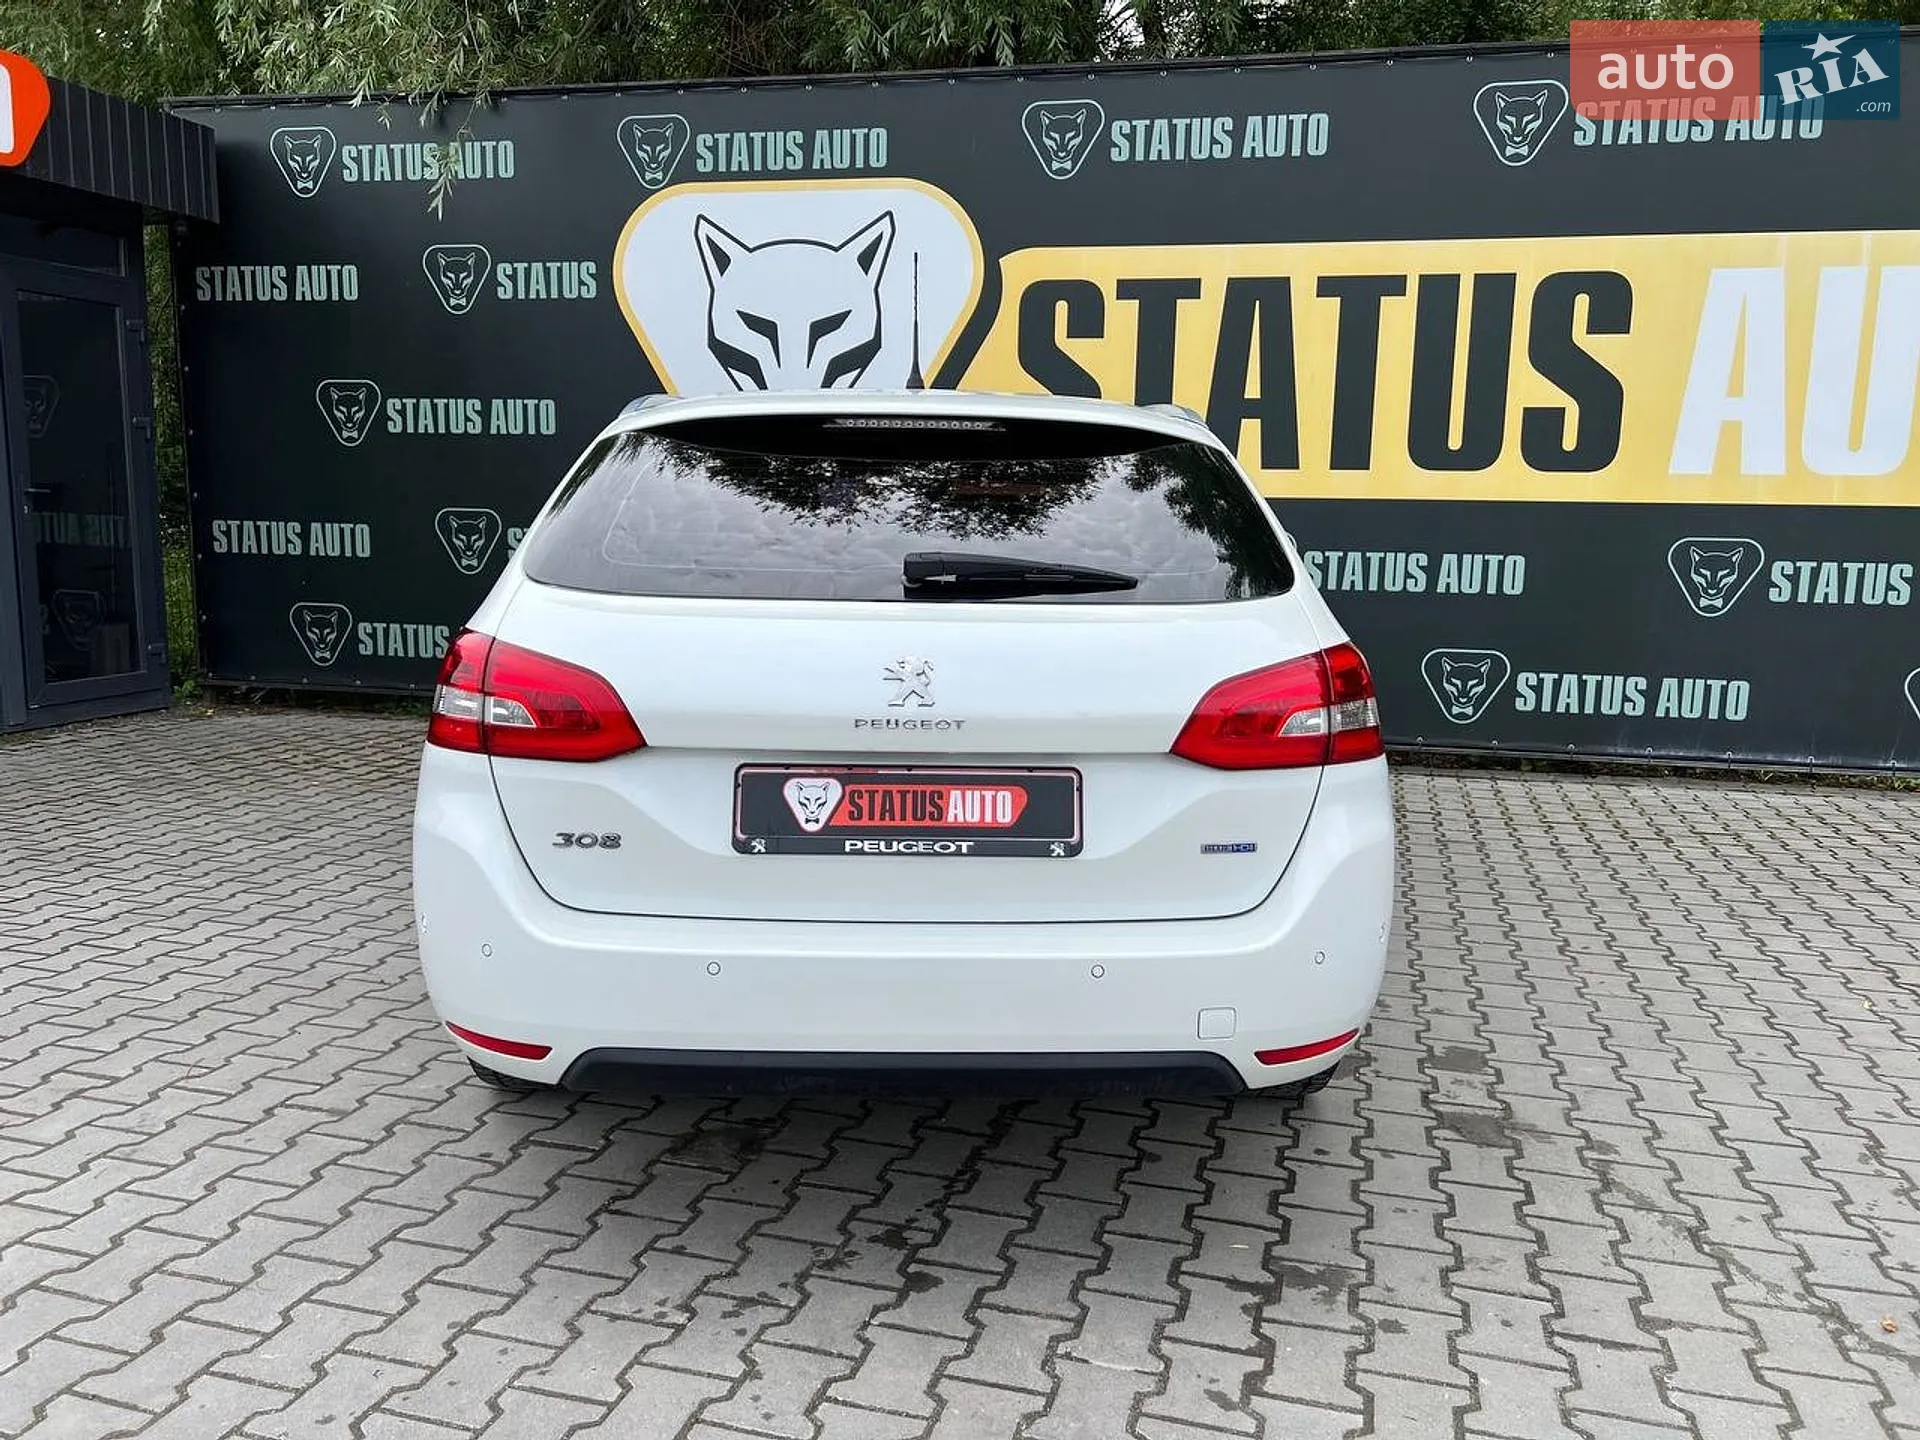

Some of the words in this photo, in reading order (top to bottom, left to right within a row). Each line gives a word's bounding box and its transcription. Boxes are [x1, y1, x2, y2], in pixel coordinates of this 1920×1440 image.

[1110, 116, 1234, 162] STATUS
[1241, 112, 1330, 159] AUTO
[1573, 95, 1717, 147] STATUS
[341, 142, 439, 182] STATUS
[448, 140, 515, 180] AUTO
[695, 130, 804, 173] STATUS
[812, 127, 888, 170] AUTO
[196, 264, 288, 302] STATUS
[295, 263, 359, 301] AUTO
[496, 261, 597, 300] STATUS
[1018, 270, 1634, 473] STATUS
[386, 397, 483, 435] STATUS
[489, 398, 556, 435] AUTO
[212, 519, 303, 556] STATUS
[309, 522, 371, 558] AUTO
[1303, 550, 1427, 593] STATUS
[1436, 553, 1526, 596] AUTO
[1768, 560, 1914, 606] STATUS
[357, 622, 450, 660] STATUS
[1514, 671, 1648, 717] STATUS
[1655, 677, 1750, 721] AUTO
[854, 718, 966, 731] PEUGEOT
[551, 832, 622, 850] 308
[844, 839, 975, 855] PEUGEOT
